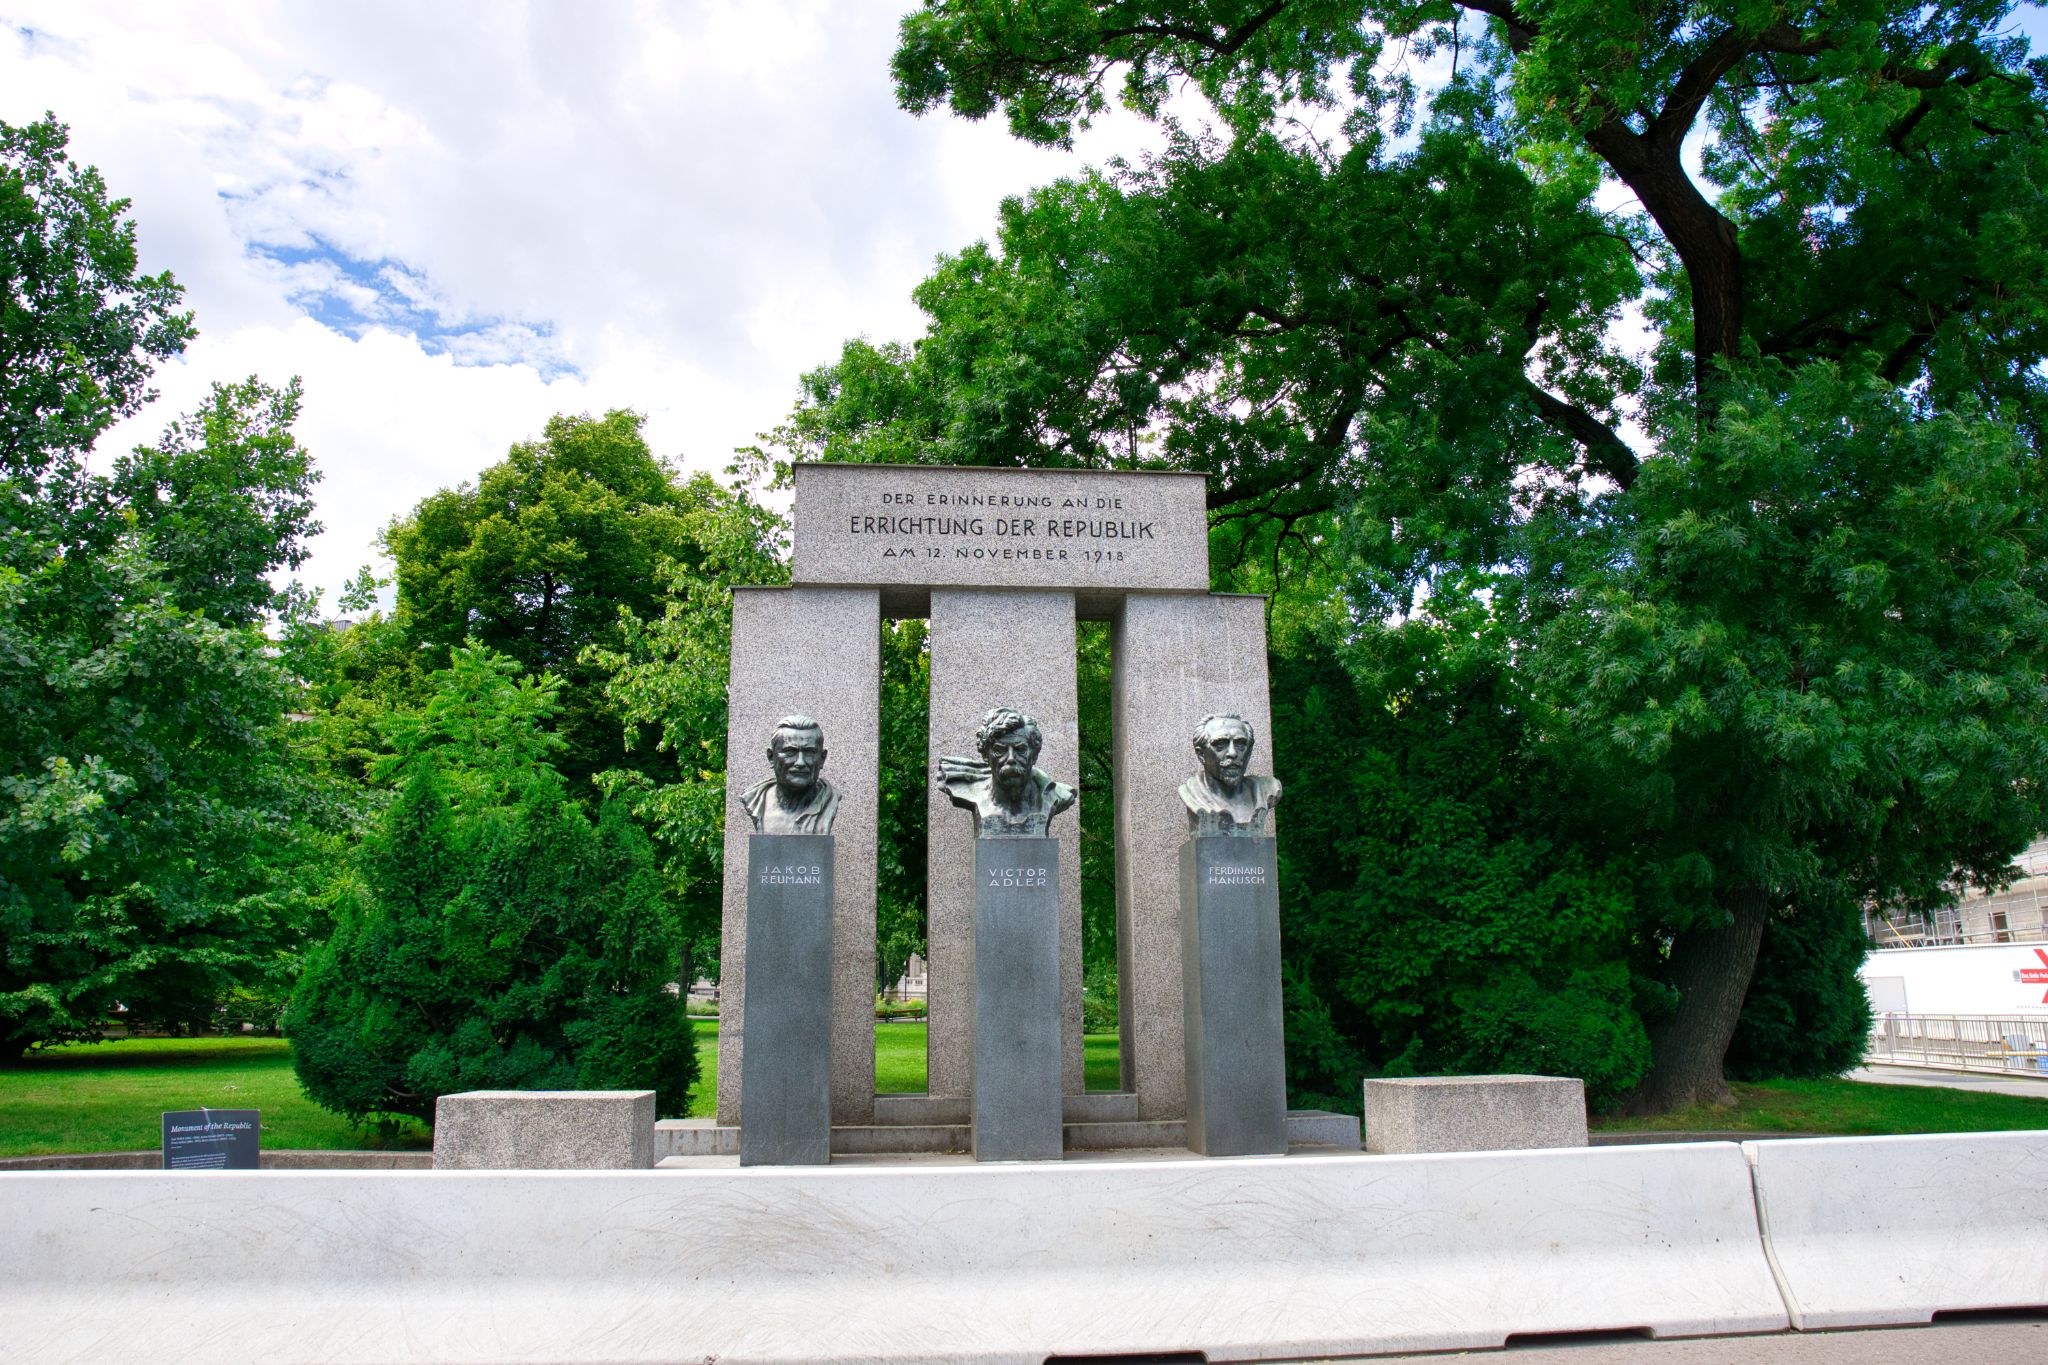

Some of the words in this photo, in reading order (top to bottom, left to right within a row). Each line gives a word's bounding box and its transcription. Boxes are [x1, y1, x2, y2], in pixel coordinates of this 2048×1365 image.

[883, 493, 914, 504] DER
[927, 494, 1052, 507] ERINNERUNG
[1062, 498, 1088, 508] AN
[1096, 498, 1122, 509] DIE
[851, 516, 983, 535] ERRICHTUNG
[996, 518, 1035, 537] DER
[1048, 520, 1154, 539] REPUBLIK
[883, 547, 916, 558] AM
[926, 548, 946, 558] 12.
[956, 548, 1068, 560] NOVEMBER
[1084, 551, 1124, 563] 1918
[761, 865, 820, 875] JAKOB
[988, 868, 1047, 877] VICTOR
[1209, 866, 1265, 875] FERDINAND
[761, 875, 821, 885] REUMANN
[988, 878, 1047, 887] ADLER
[1209, 876, 1265, 885] HANUSCH
[171, 1125, 203, 1133] Monument
[203, 1122, 212, 1132] of
[211, 1121, 223, 1130] the
[223, 1121, 252, 1131] Republic
